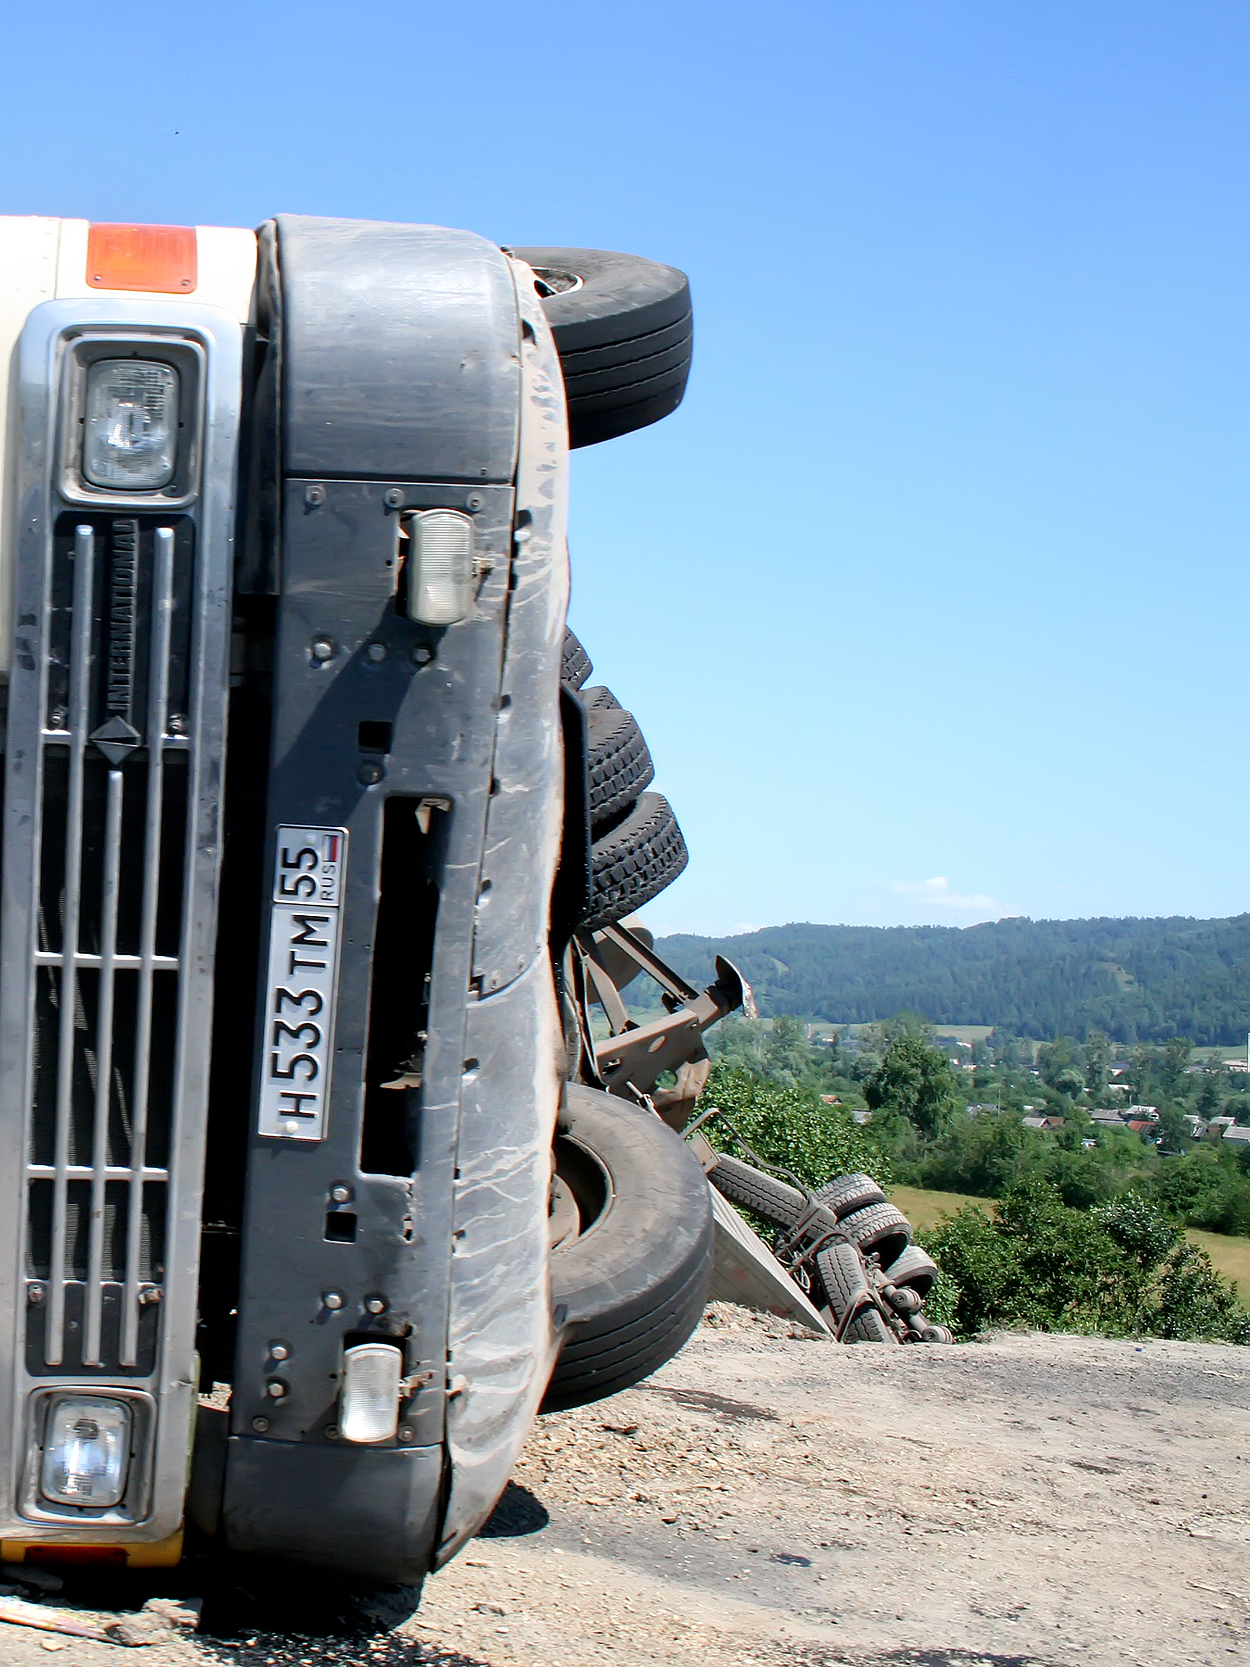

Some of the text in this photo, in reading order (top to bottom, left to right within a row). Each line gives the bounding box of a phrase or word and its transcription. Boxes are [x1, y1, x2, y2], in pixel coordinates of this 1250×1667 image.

[106, 518, 137, 711] INTERNATIONAL
[279, 846, 319, 899] 55
[321, 865, 336, 901] RUS
